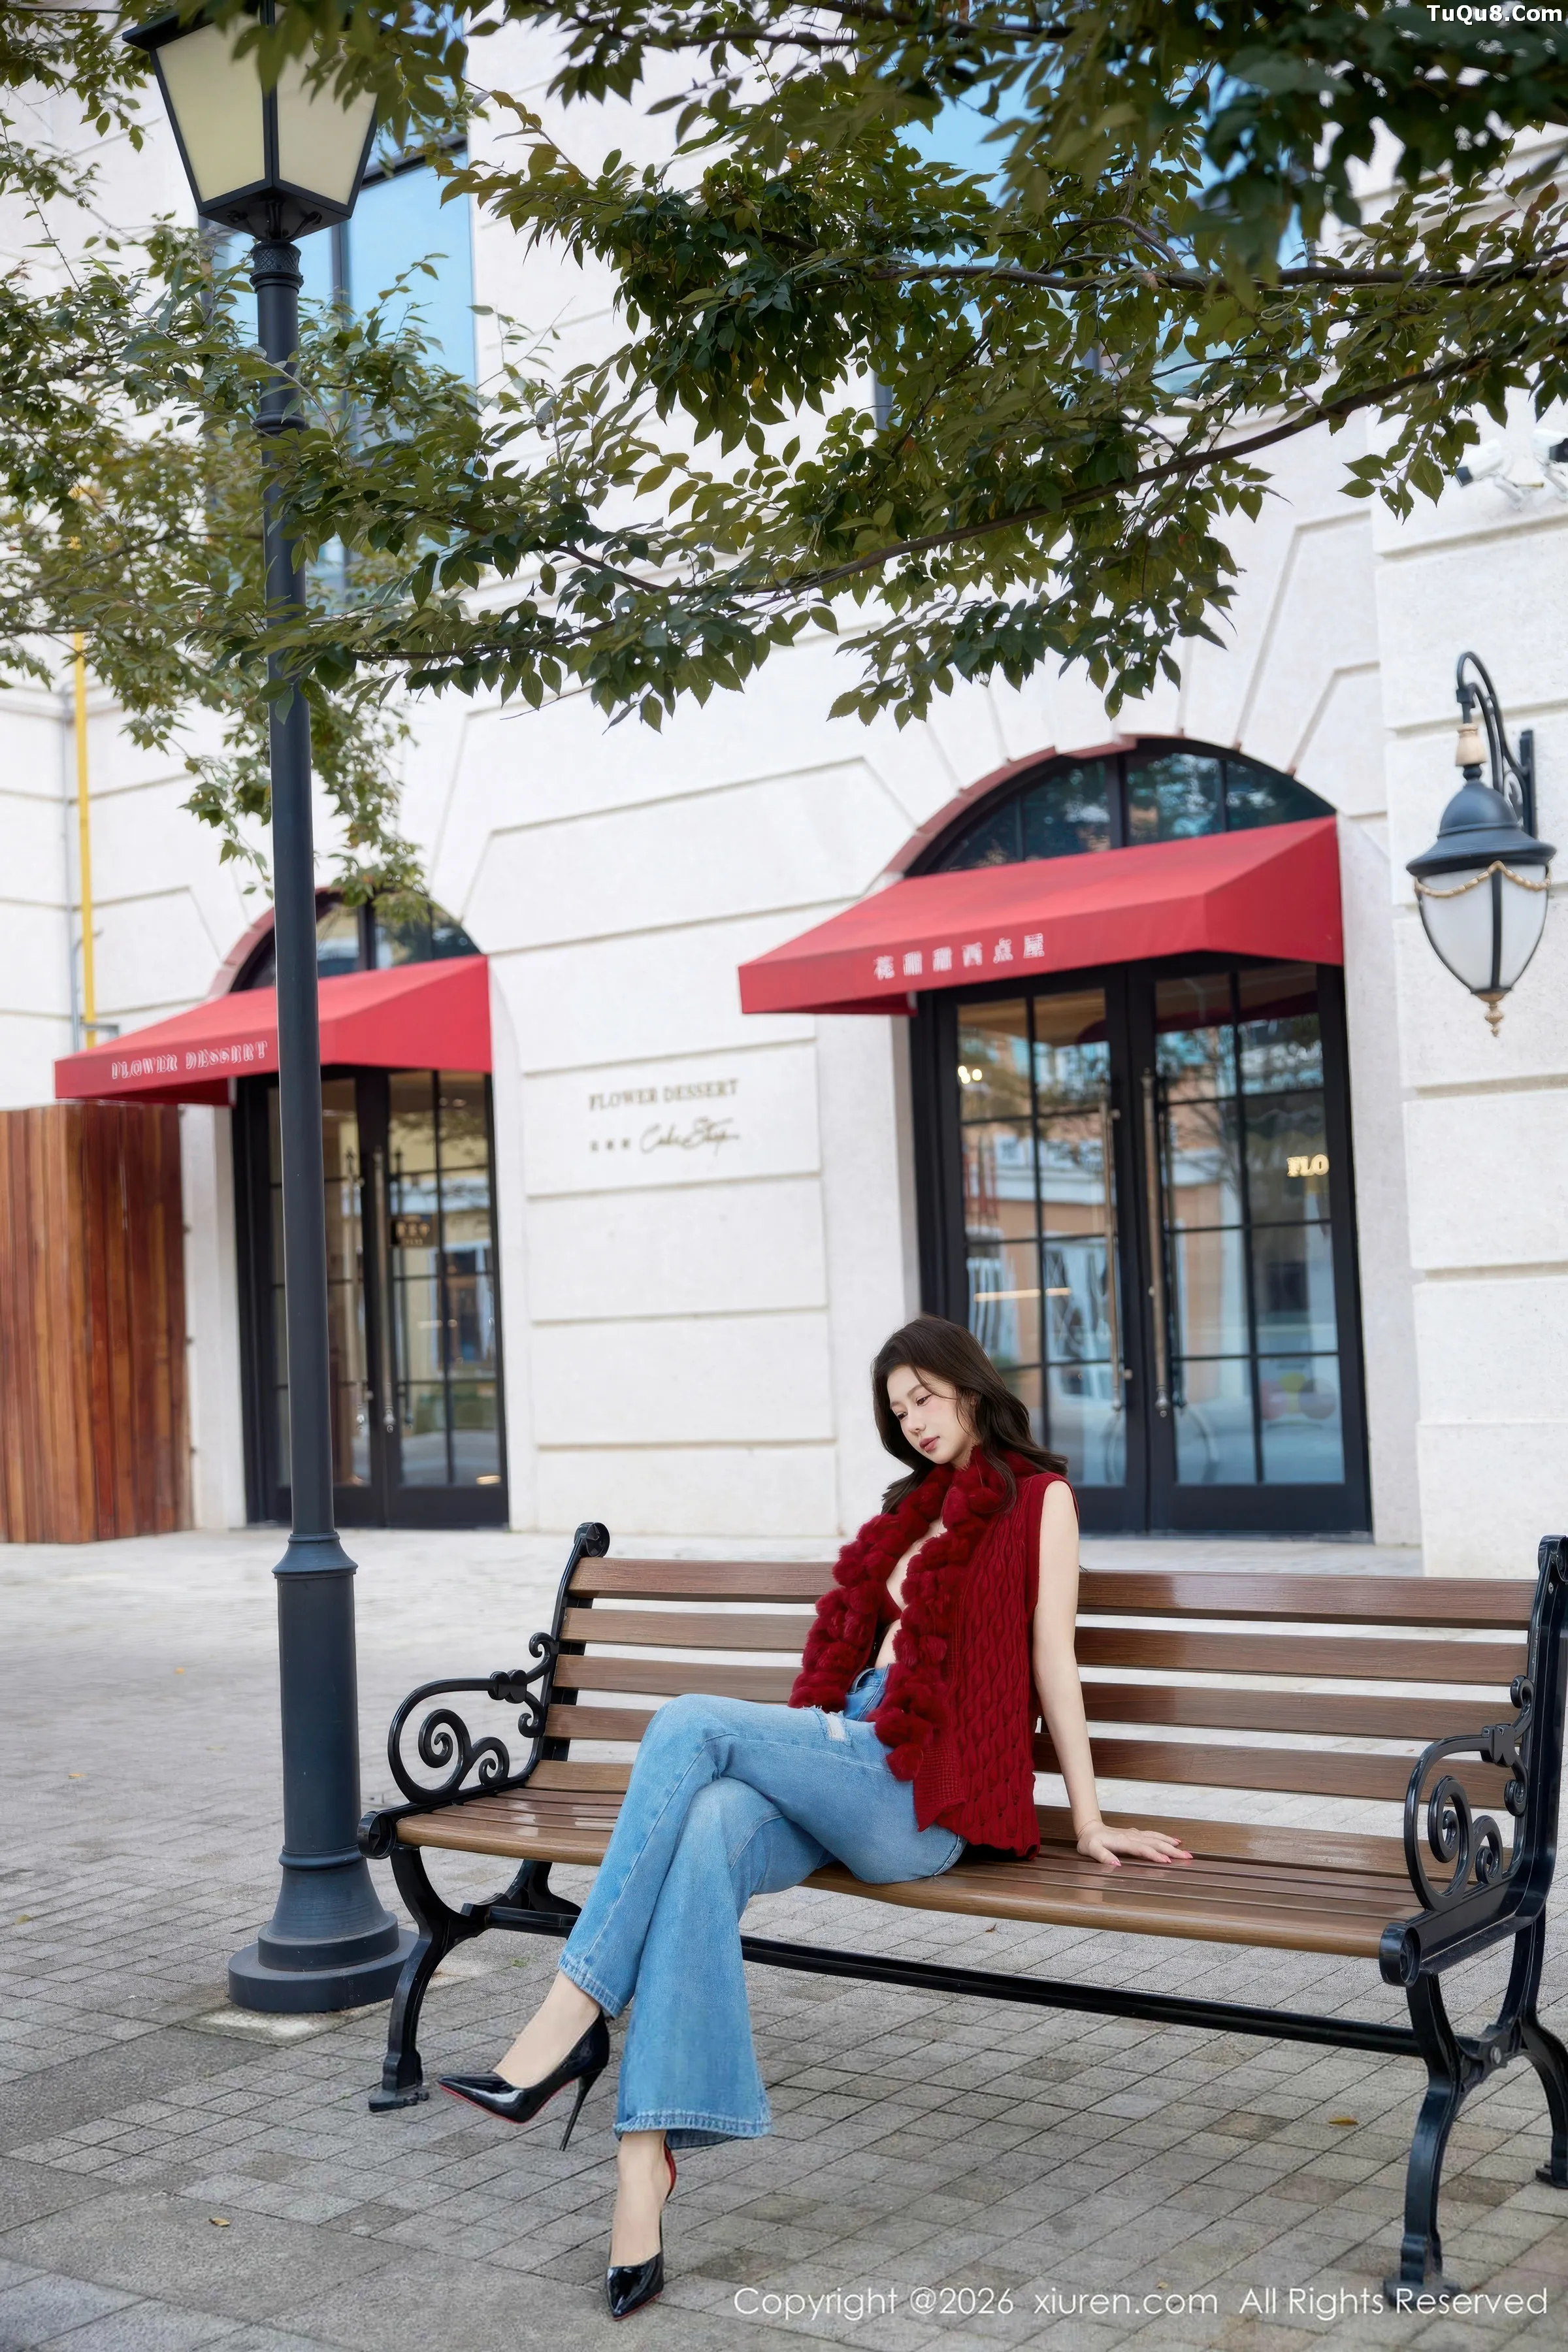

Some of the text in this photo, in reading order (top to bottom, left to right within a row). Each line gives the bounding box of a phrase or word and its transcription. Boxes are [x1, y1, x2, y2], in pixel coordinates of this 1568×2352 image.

[112, 1040, 268, 1079] FLOWER DESSERT
[589, 1079, 740, 1111] FLOWER DESSERT
